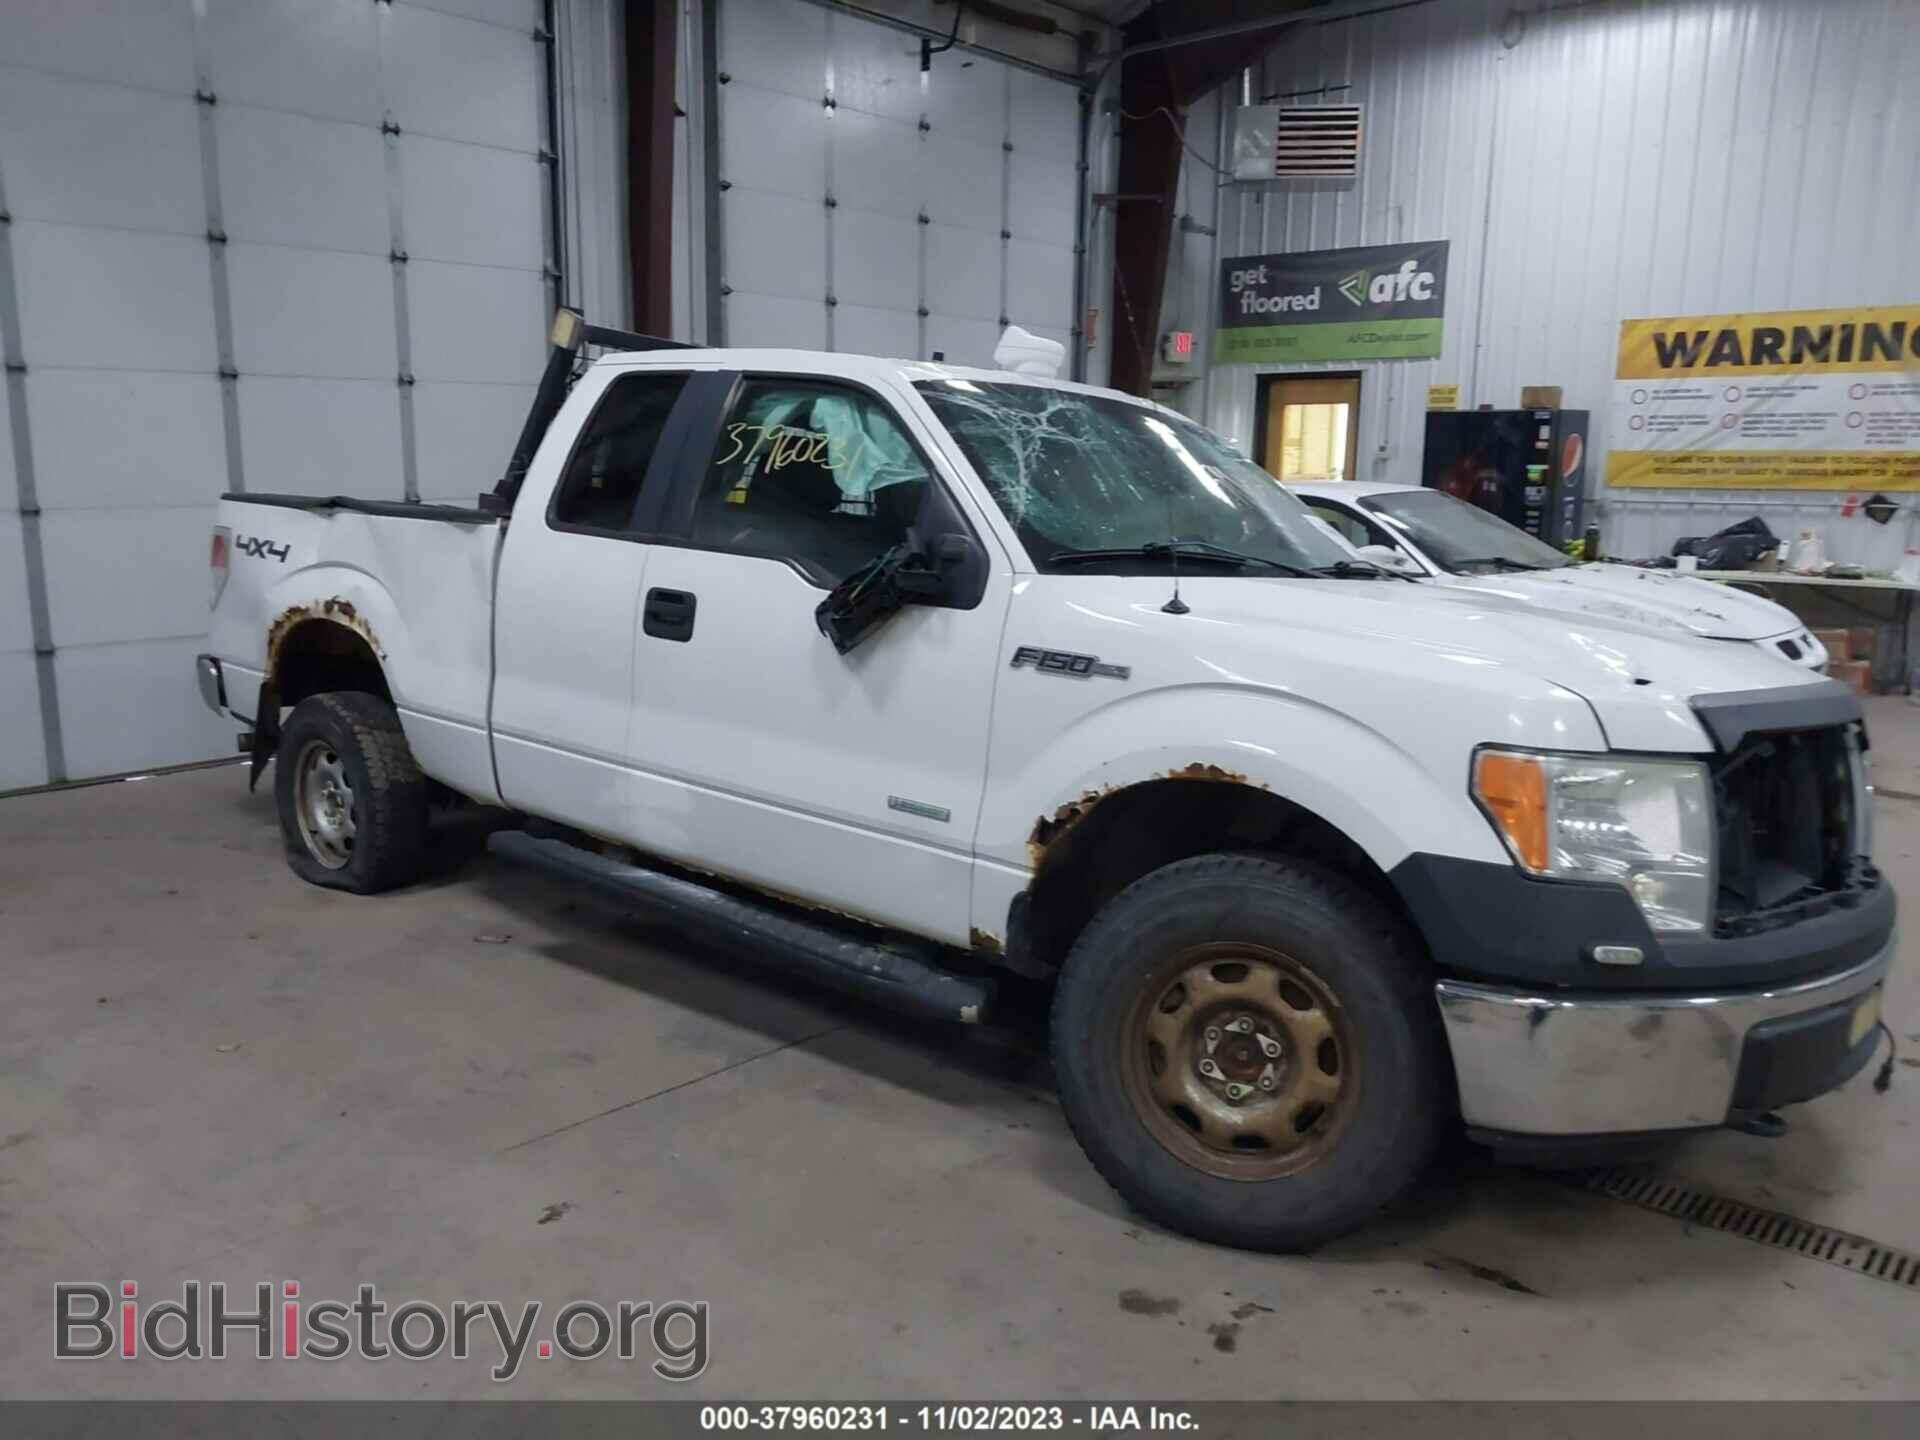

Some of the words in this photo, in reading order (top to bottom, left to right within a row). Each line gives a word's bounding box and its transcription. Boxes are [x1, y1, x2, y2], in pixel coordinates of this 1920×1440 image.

[1230, 264, 1268, 292] get
[1369, 260, 1435, 303] afc
[1240, 286, 1321, 314] floored
